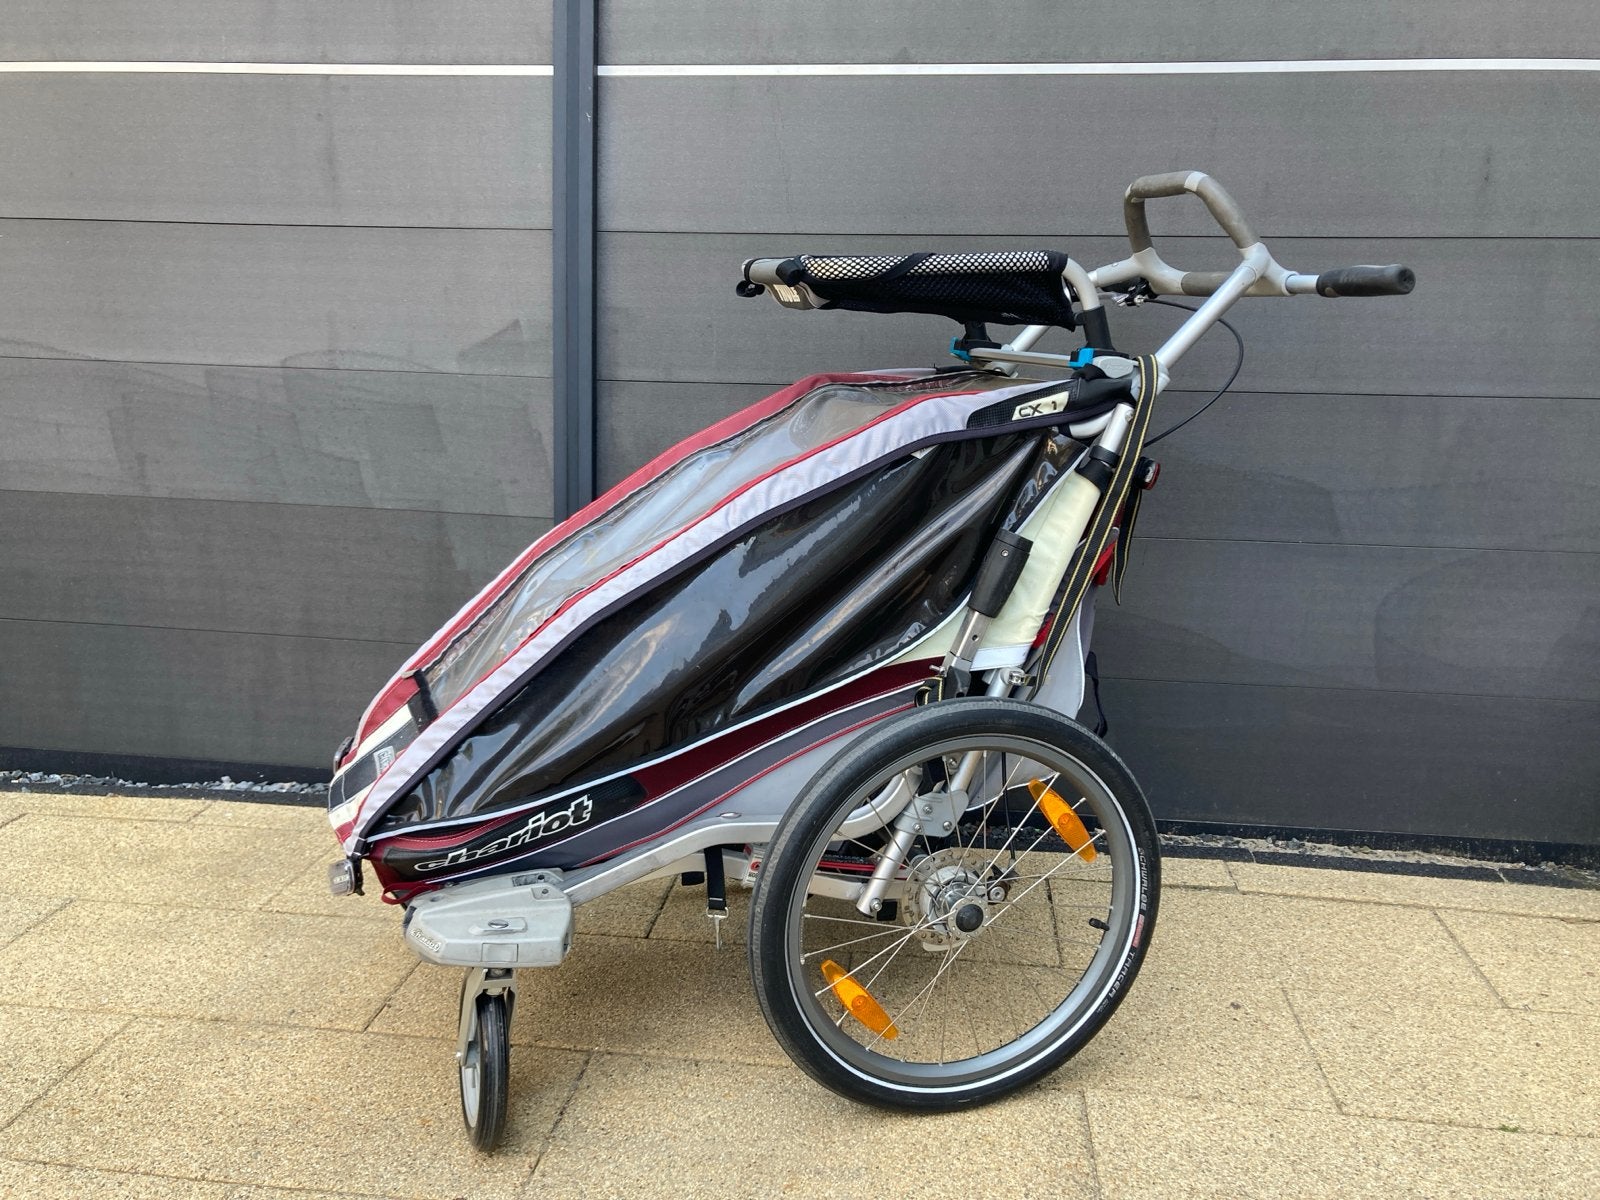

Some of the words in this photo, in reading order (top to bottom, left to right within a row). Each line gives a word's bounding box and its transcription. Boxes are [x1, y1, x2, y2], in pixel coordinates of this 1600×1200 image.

[1018, 402, 1043, 418] CX
[1051, 400, 1058, 411] 1
[414, 793, 593, 872] chariot
[1137, 847, 1149, 911] SCHWALBE
